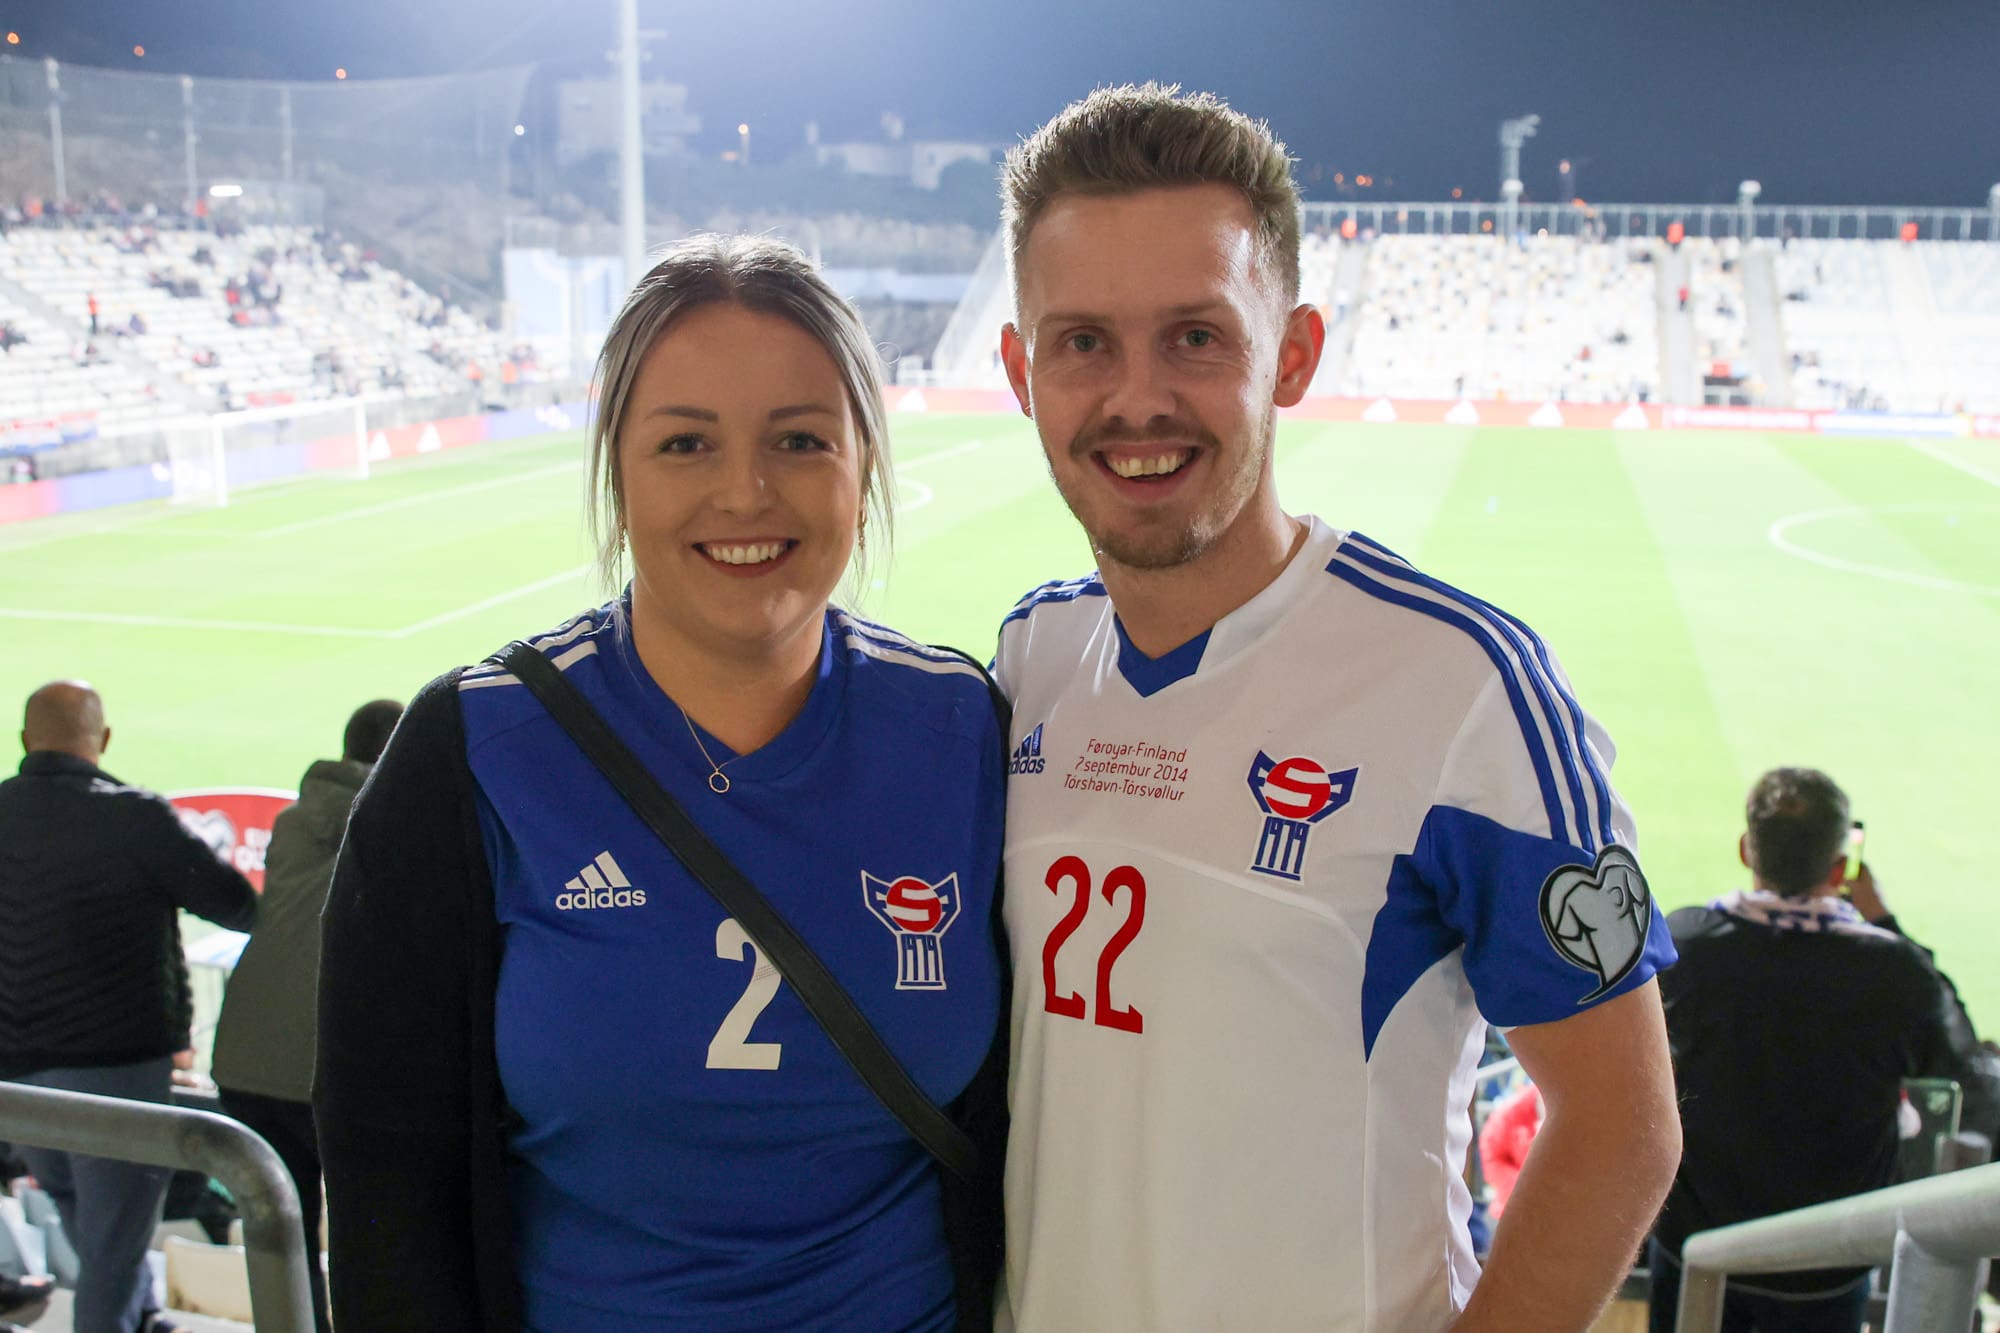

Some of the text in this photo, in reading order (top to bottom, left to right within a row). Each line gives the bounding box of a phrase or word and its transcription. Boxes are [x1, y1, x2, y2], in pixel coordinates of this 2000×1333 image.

[1087, 739, 1187, 762] Føroyar-Finland
[1009, 757, 1046, 774] didas
[1084, 761, 1151, 776] septembur
[1153, 764, 1188, 782] 2014
[555, 886, 647, 911] adidas
[1042, 855, 1146, 1034] 22
[705, 918, 782, 1070] 2
